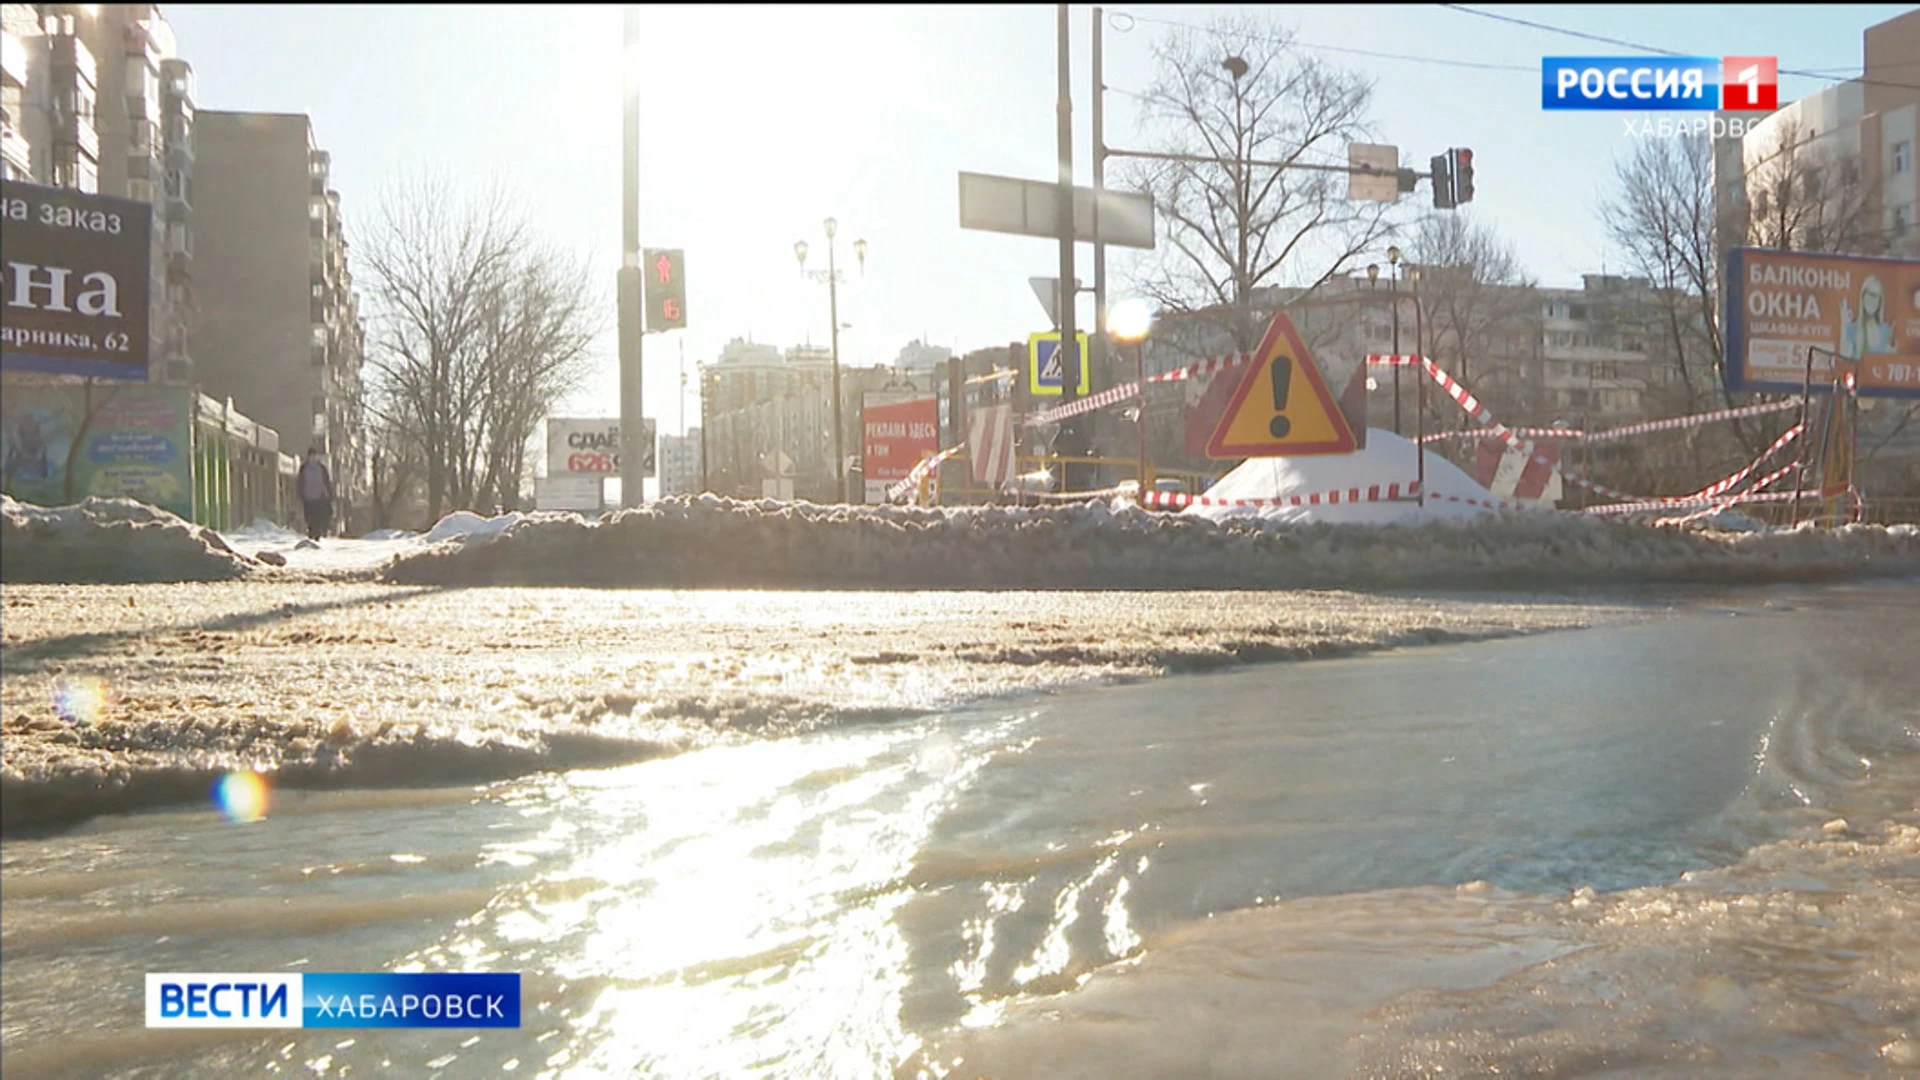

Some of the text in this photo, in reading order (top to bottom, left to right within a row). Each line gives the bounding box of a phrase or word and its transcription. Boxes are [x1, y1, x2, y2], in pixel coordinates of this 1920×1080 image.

[39, 203, 122, 235] заказ
[0, 261, 123, 318] на
[1749, 263, 1851, 291] БАЛКОНЫ
[1748, 289, 1821, 320] ОКНА
[104, 332, 130, 351] 62
[568, 426, 621, 450] СДАЁ
[908, 422, 937, 440] ЗДЕСЬ
